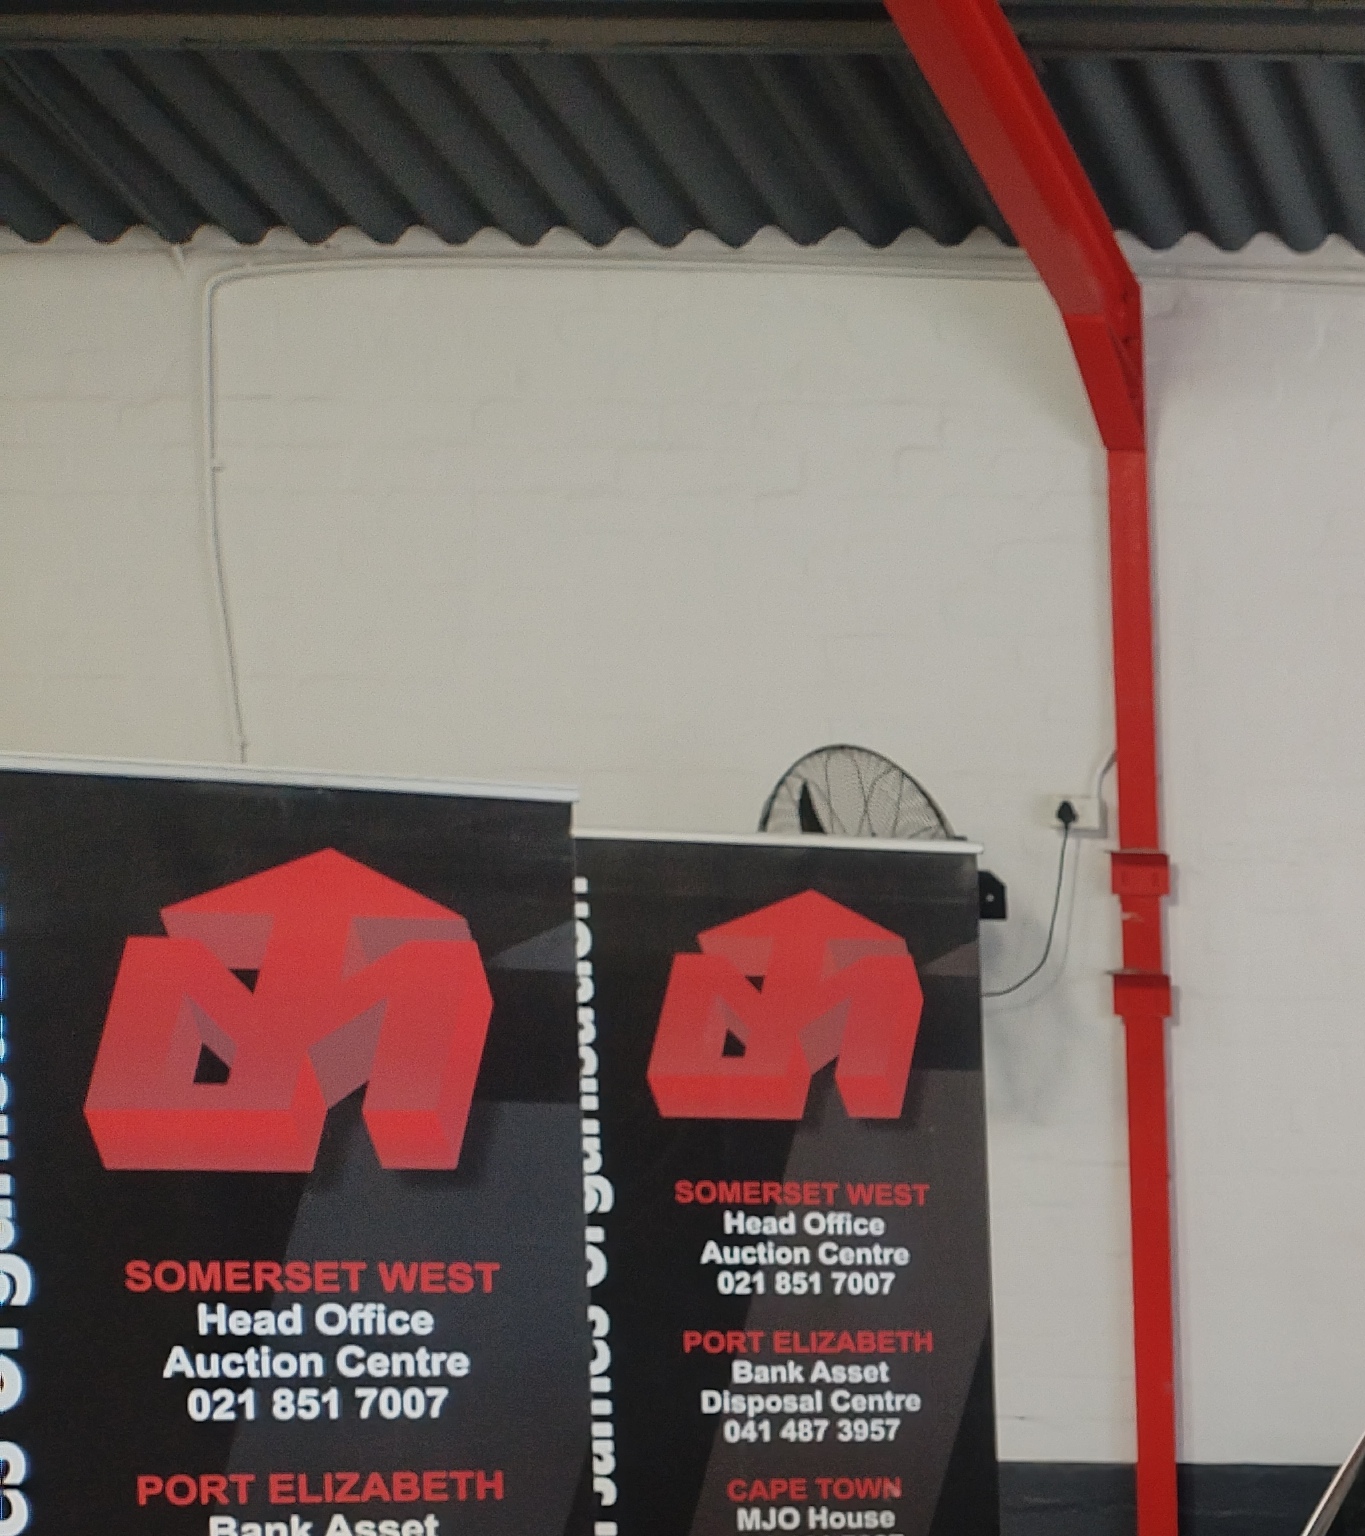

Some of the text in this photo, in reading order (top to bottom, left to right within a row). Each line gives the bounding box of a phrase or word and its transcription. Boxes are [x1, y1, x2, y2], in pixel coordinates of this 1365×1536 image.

[674, 1179, 931, 1208] SOMERSET WEST
[723, 1209, 886, 1236] Head Office
[700, 1239, 911, 1266] Auction Centre
[124, 1259, 501, 1294] SOMERSET WEST
[717, 1270, 896, 1296] 021 851 7007
[197, 1302, 435, 1336] Head Office
[682, 1329, 935, 1355] PORT ELIZABETH
[162, 1344, 471, 1379] Auction Centre
[731, 1359, 890, 1384] Bank Asset
[187, 1386, 450, 1422] 021 851 7007
[700, 1388, 922, 1419] Disposal Centre
[723, 1417, 901, 1444] 041 487 3957
[136, 1469, 505, 1507] PORT ELIZABETH
[726, 1476, 903, 1503] CAPE TOWN
[736, 1505, 896, 1532] MJO House
